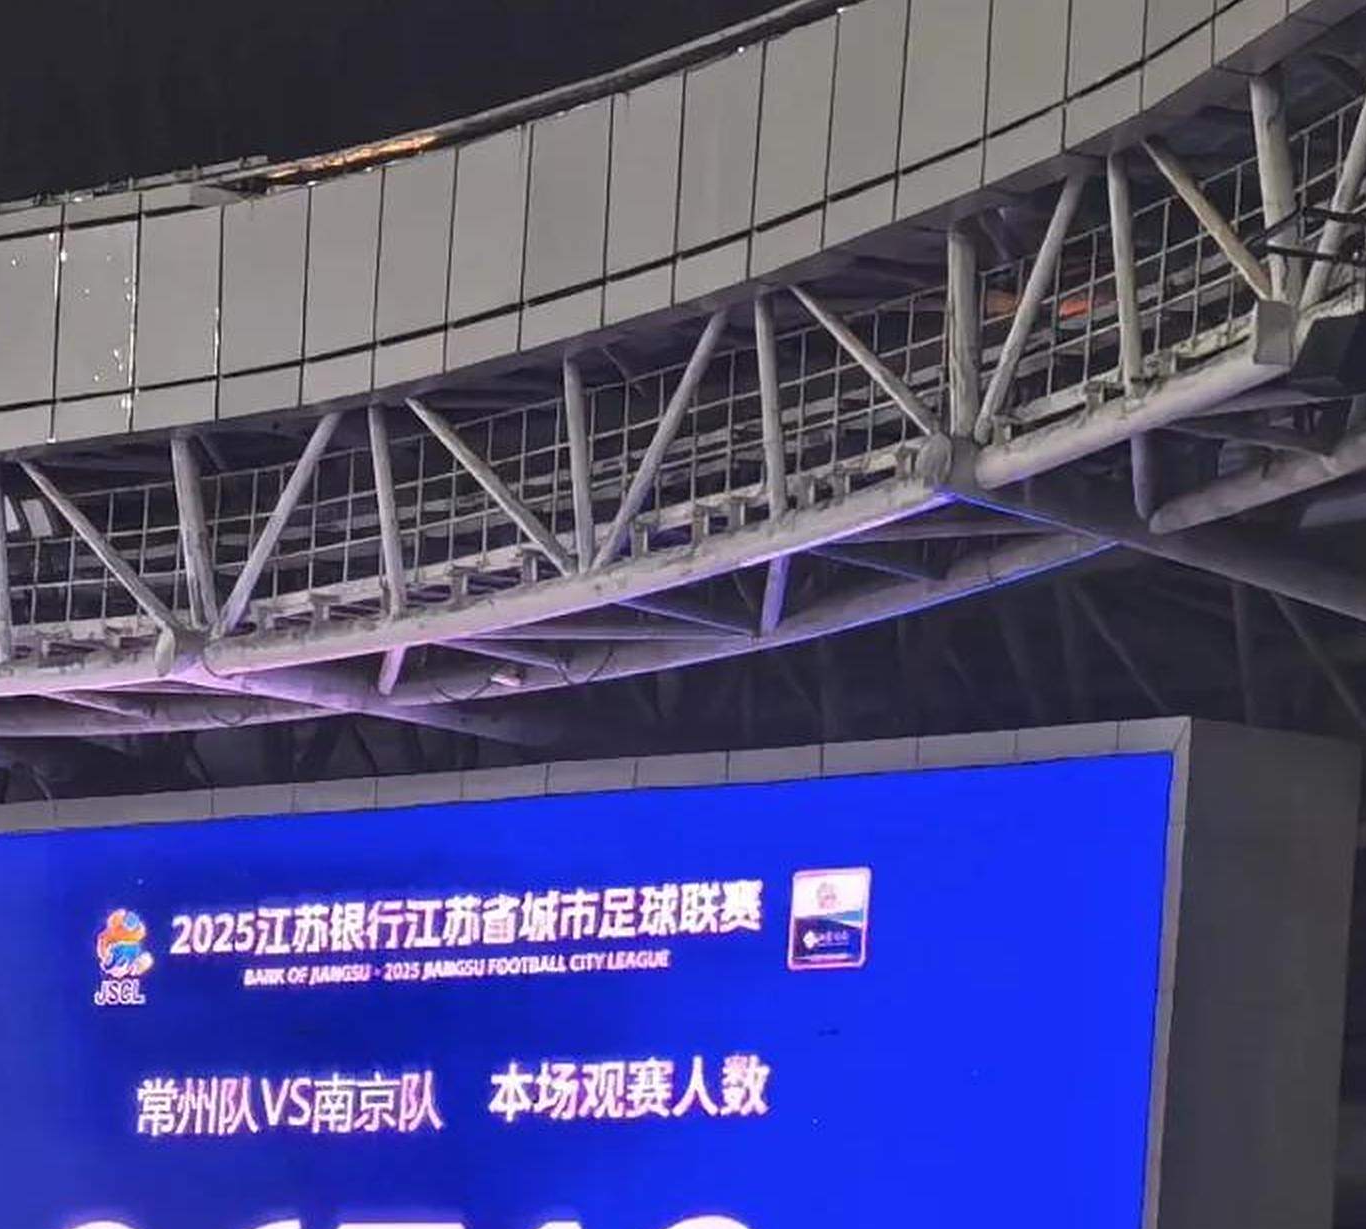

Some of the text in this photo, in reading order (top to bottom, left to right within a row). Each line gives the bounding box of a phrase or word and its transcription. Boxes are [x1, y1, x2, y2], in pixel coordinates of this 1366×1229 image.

[169, 879, 764, 956] 2025江苏银行江苏省城市足球联赛
[94, 979, 146, 1006] JSCL
[243, 948, 671, 987] BANK OF JIANGSU 2025 JIANGSU FOOTBALL CITY LEAGUE
[135, 1052, 772, 1137] 常州队VS南京队 本场观赛人数
